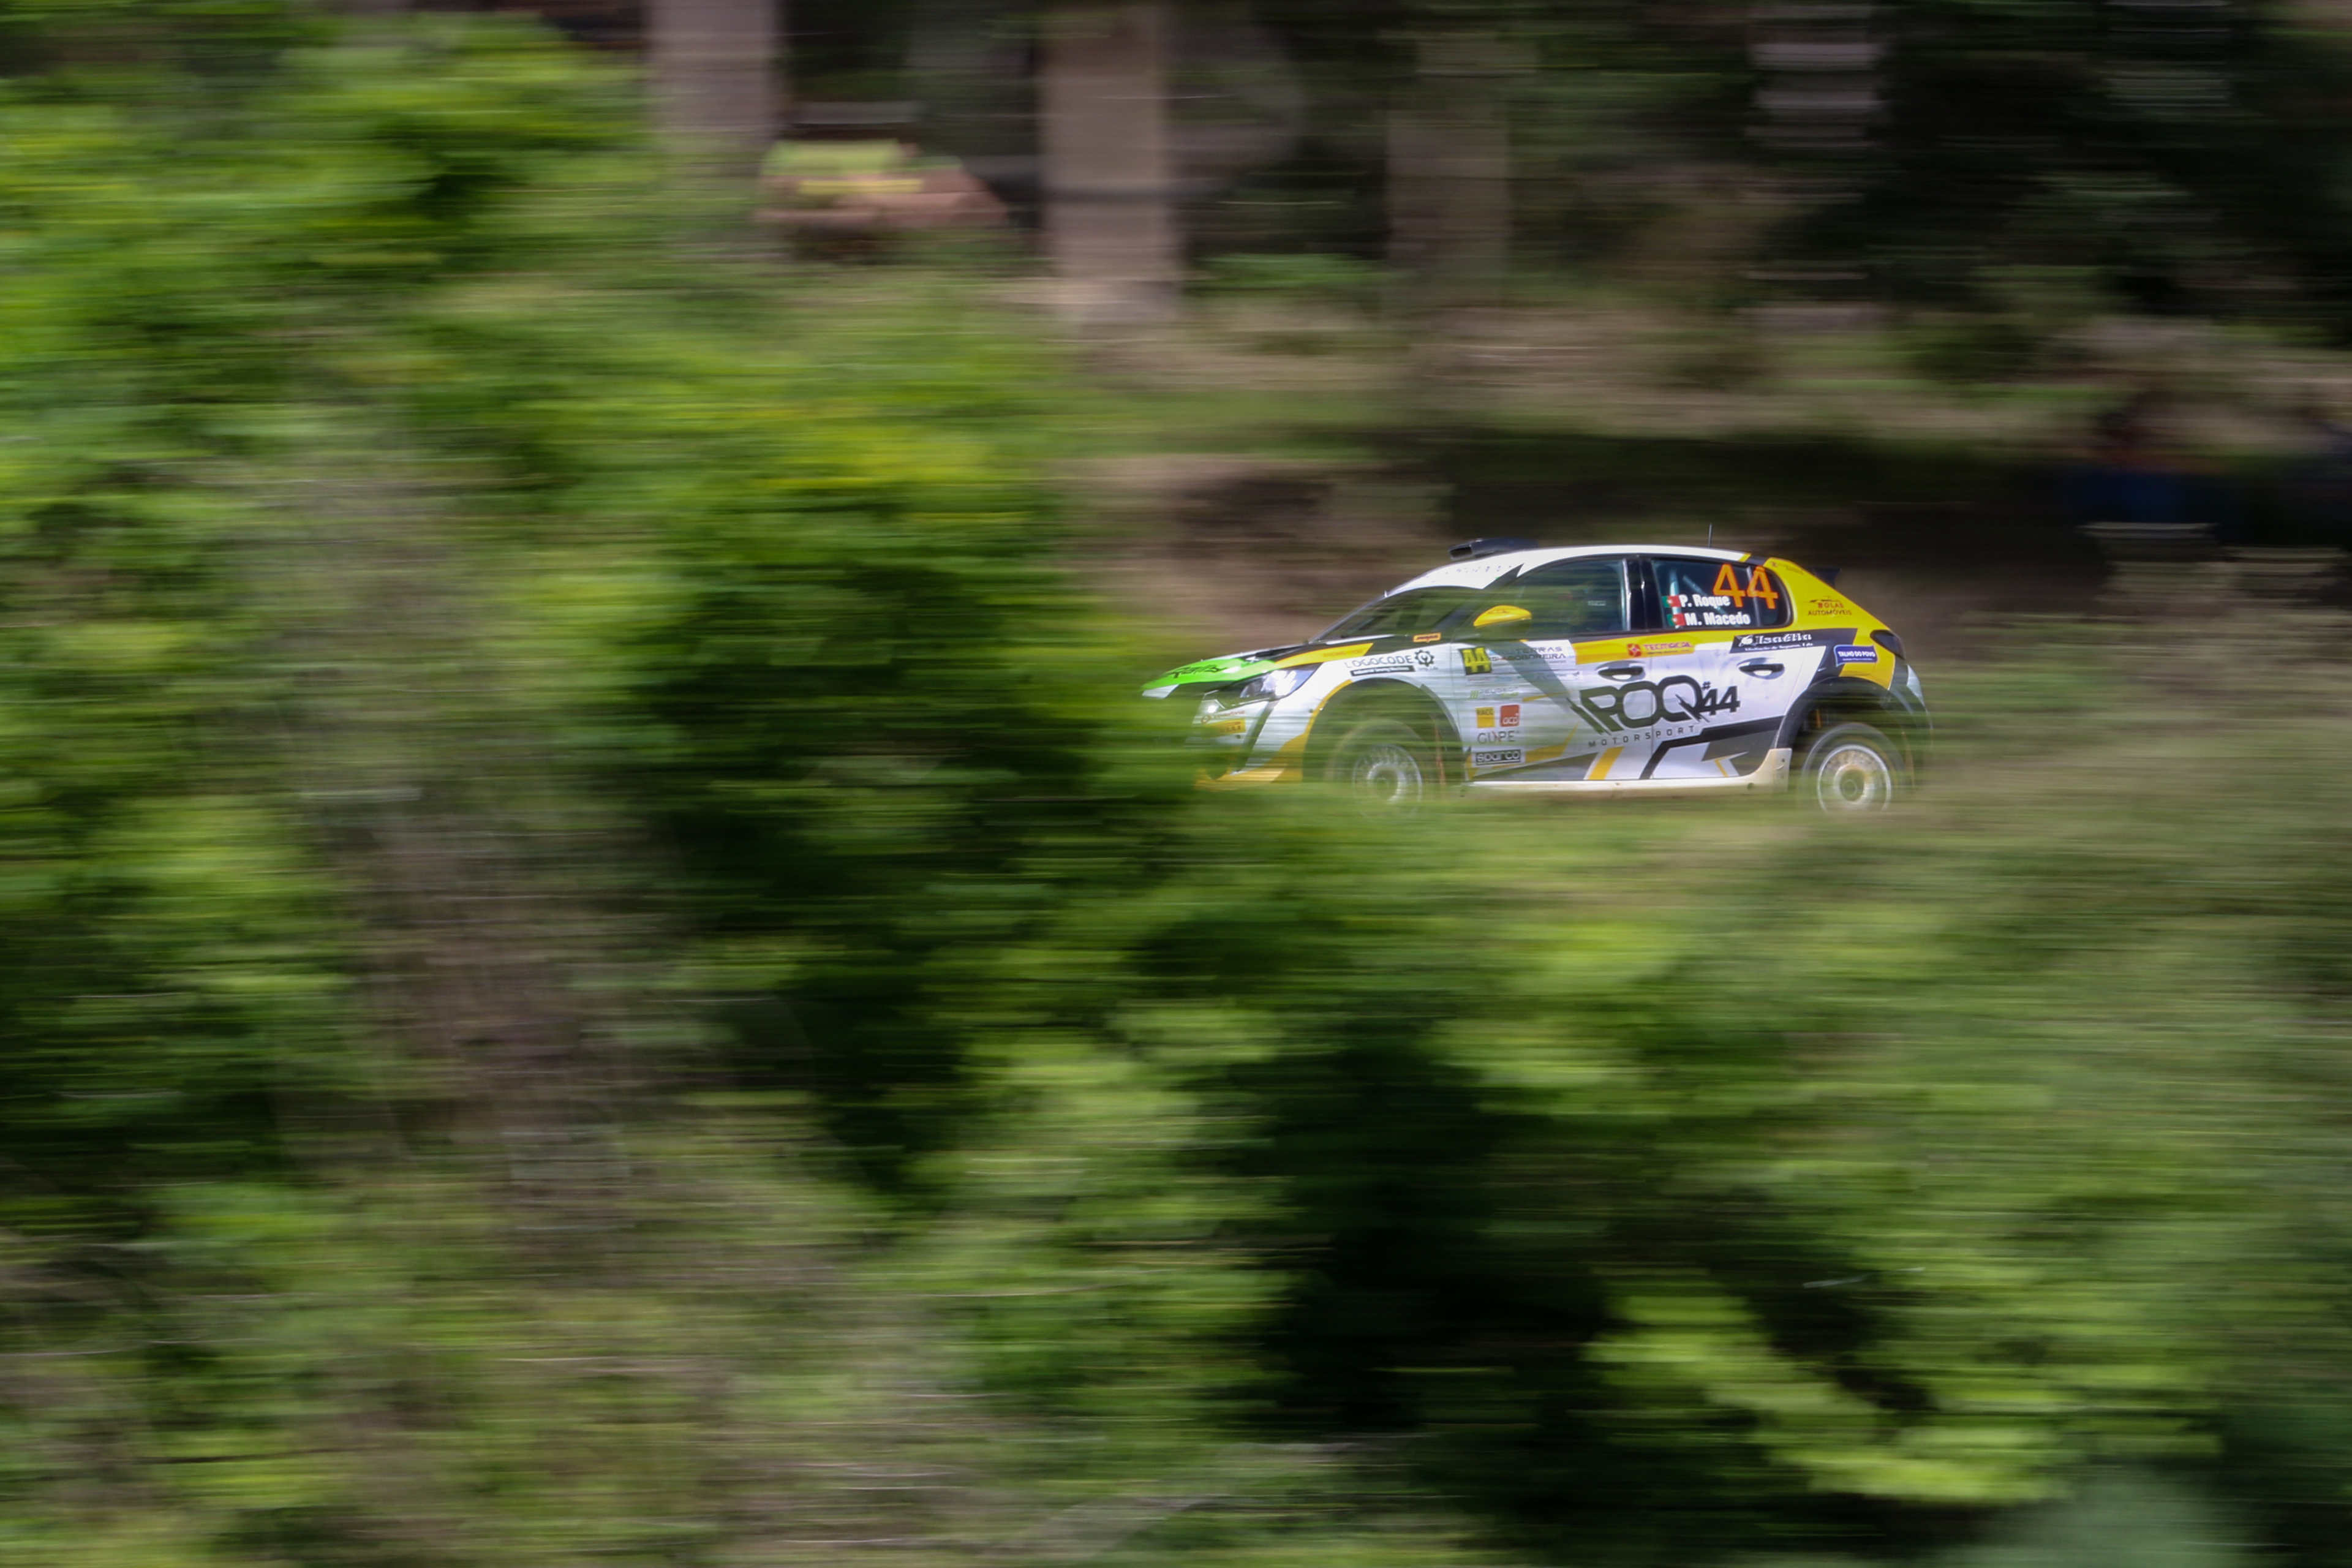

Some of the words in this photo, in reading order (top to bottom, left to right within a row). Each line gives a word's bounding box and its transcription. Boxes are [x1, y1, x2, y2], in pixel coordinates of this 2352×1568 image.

[1713, 564, 1778, 609] 44
[1679, 595, 1692, 607] P.
[1692, 594, 1730, 608] Roque
[1818, 602, 1844, 611] BOLAS
[1685, 613, 1702, 625] M.
[1703, 611, 1751, 625] Macedo
[1807, 608, 1852, 619] AUTOMÓVEIS
[1344, 655, 1414, 669] LOGOCODE
[1463, 647, 1491, 673] 44
[1502, 717, 1518, 725] acp
[1588, 725, 1695, 747] MOTORSPORT
[1477, 751, 1520, 762] sparco
